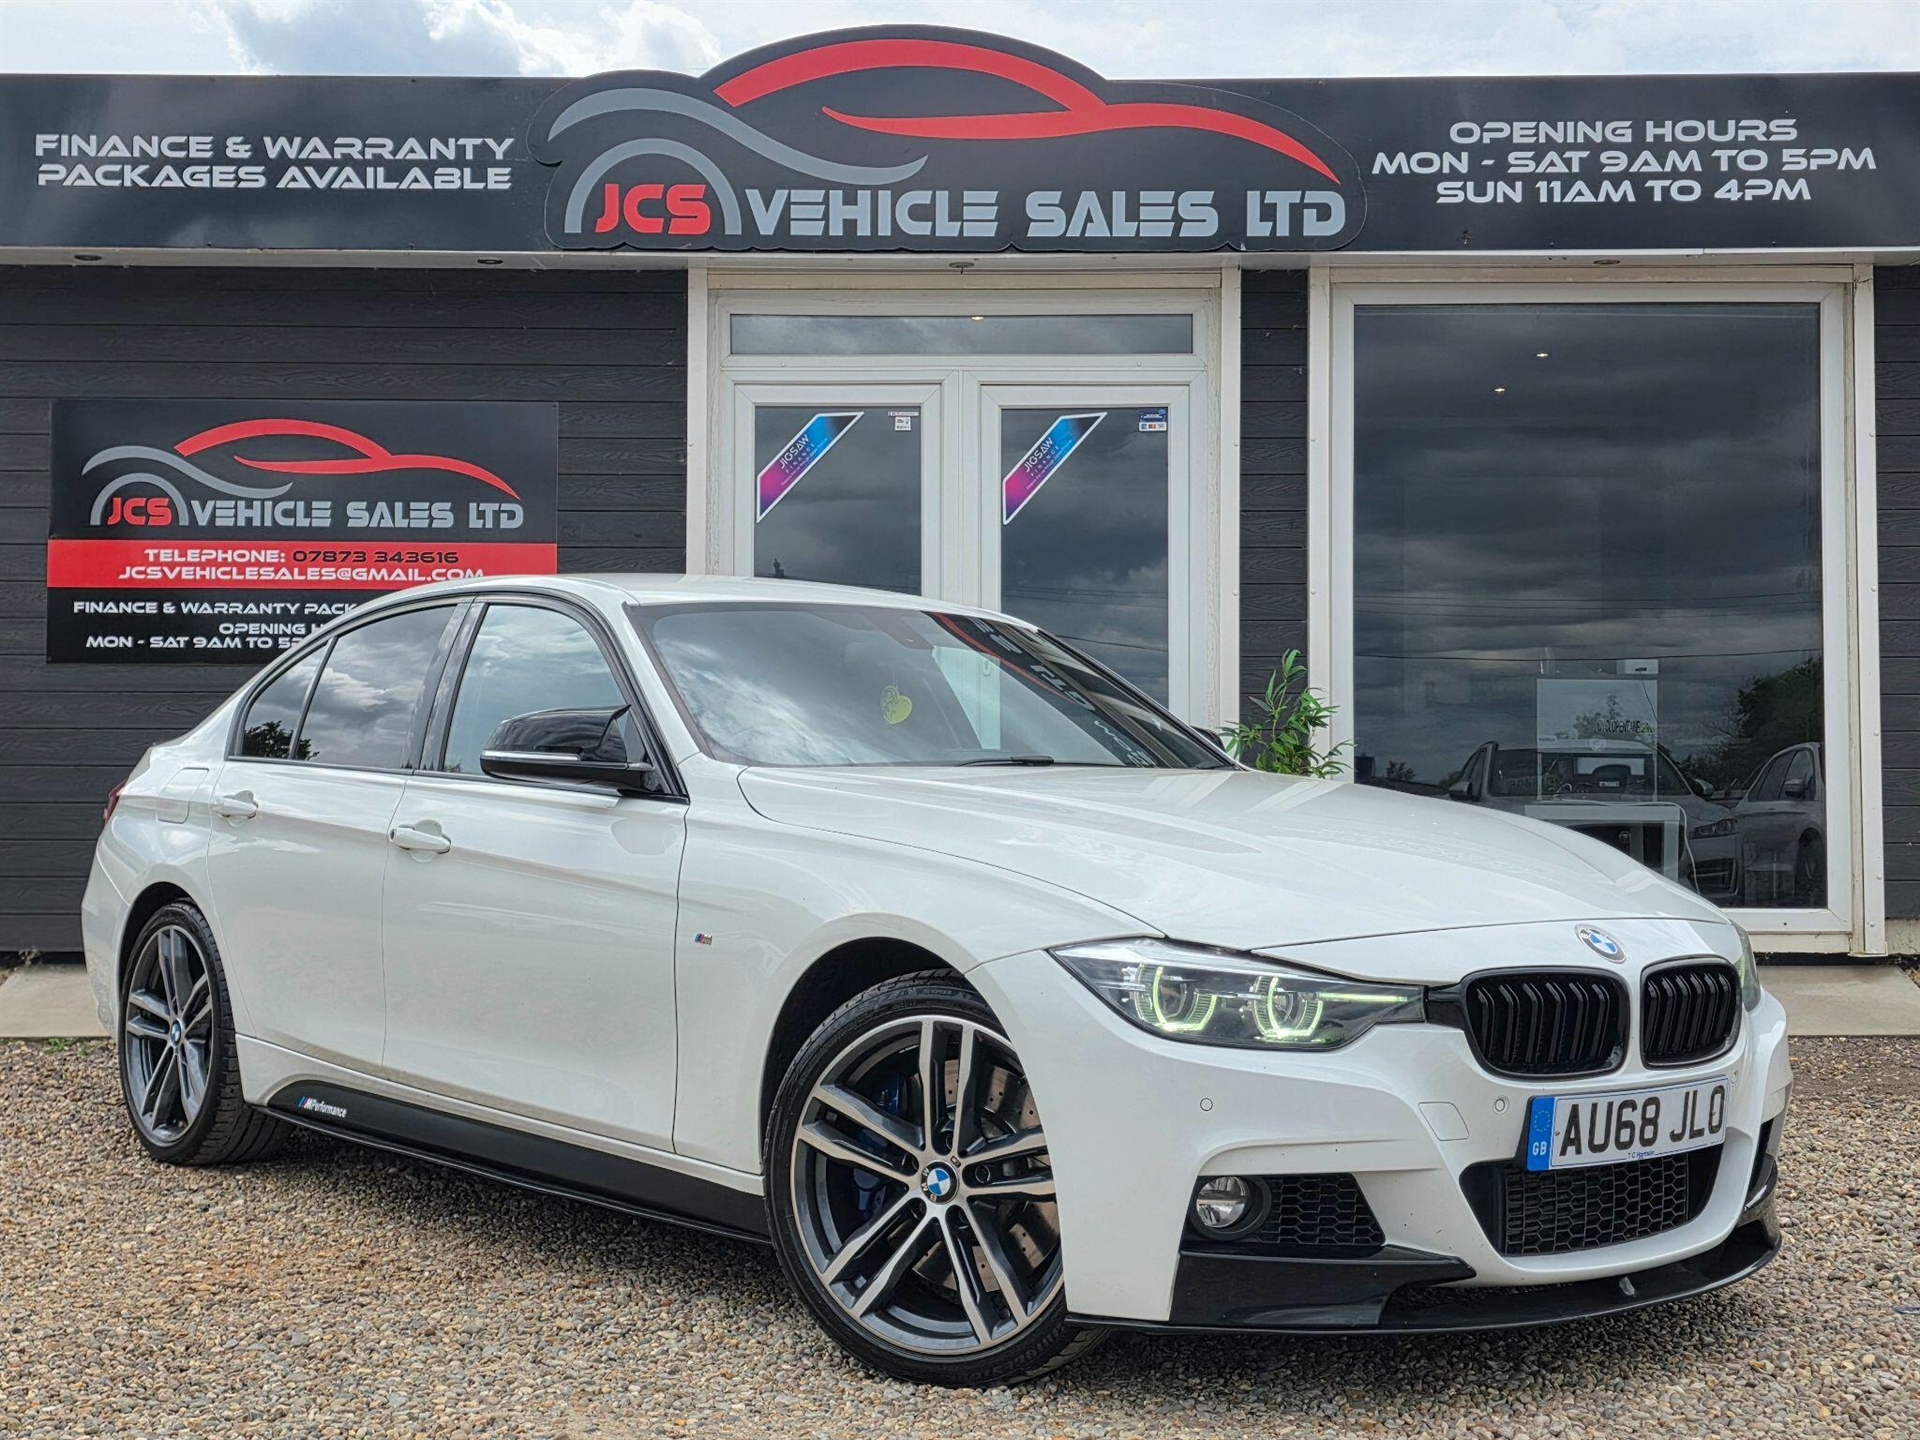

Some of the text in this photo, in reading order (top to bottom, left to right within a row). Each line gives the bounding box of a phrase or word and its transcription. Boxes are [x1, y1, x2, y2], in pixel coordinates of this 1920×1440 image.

[1449, 118, 1798, 144] OPENING HOURS
[35, 133, 515, 160] FINANCE & WARRANTY
[1371, 151, 1469, 175] MON
[1507, 150, 1591, 174] SAT
[1599, 149, 1703, 173] 9AM
[1710, 148, 1769, 172] TO
[1781, 147, 1877, 171] 5PM
[38, 163, 512, 190] PACKAGES AVAILABLE
[1436, 177, 1812, 204] SUN 11AM TO 4PM
[595, 183, 1346, 237] JCS VEHICLE SALES LTD
[779, 433, 810, 470] JIGSAW
[1023, 436, 1054, 473] JIGSAW
[107, 497, 524, 529] JCS VEHICLE SALES LTD
[144, 548, 459, 564] TELEPHONE: 07873 343616
[118, 566, 484, 582] JCSVEHICLESALES@GMAIL.COM
[73, 601, 158, 614] FINANCE
[162, 602, 176, 614] &
[180, 602, 300, 615] WARRANTY
[85, 635, 133, 648] MON
[149, 636, 190, 649] SAT
[193, 636, 242, 649] 9AM
[245, 636, 273, 649] TO
[218, 622, 306, 635] OPENING
[1559, 1085, 1726, 1157] AU68 JLO
[1532, 1141, 1547, 1156] GB
